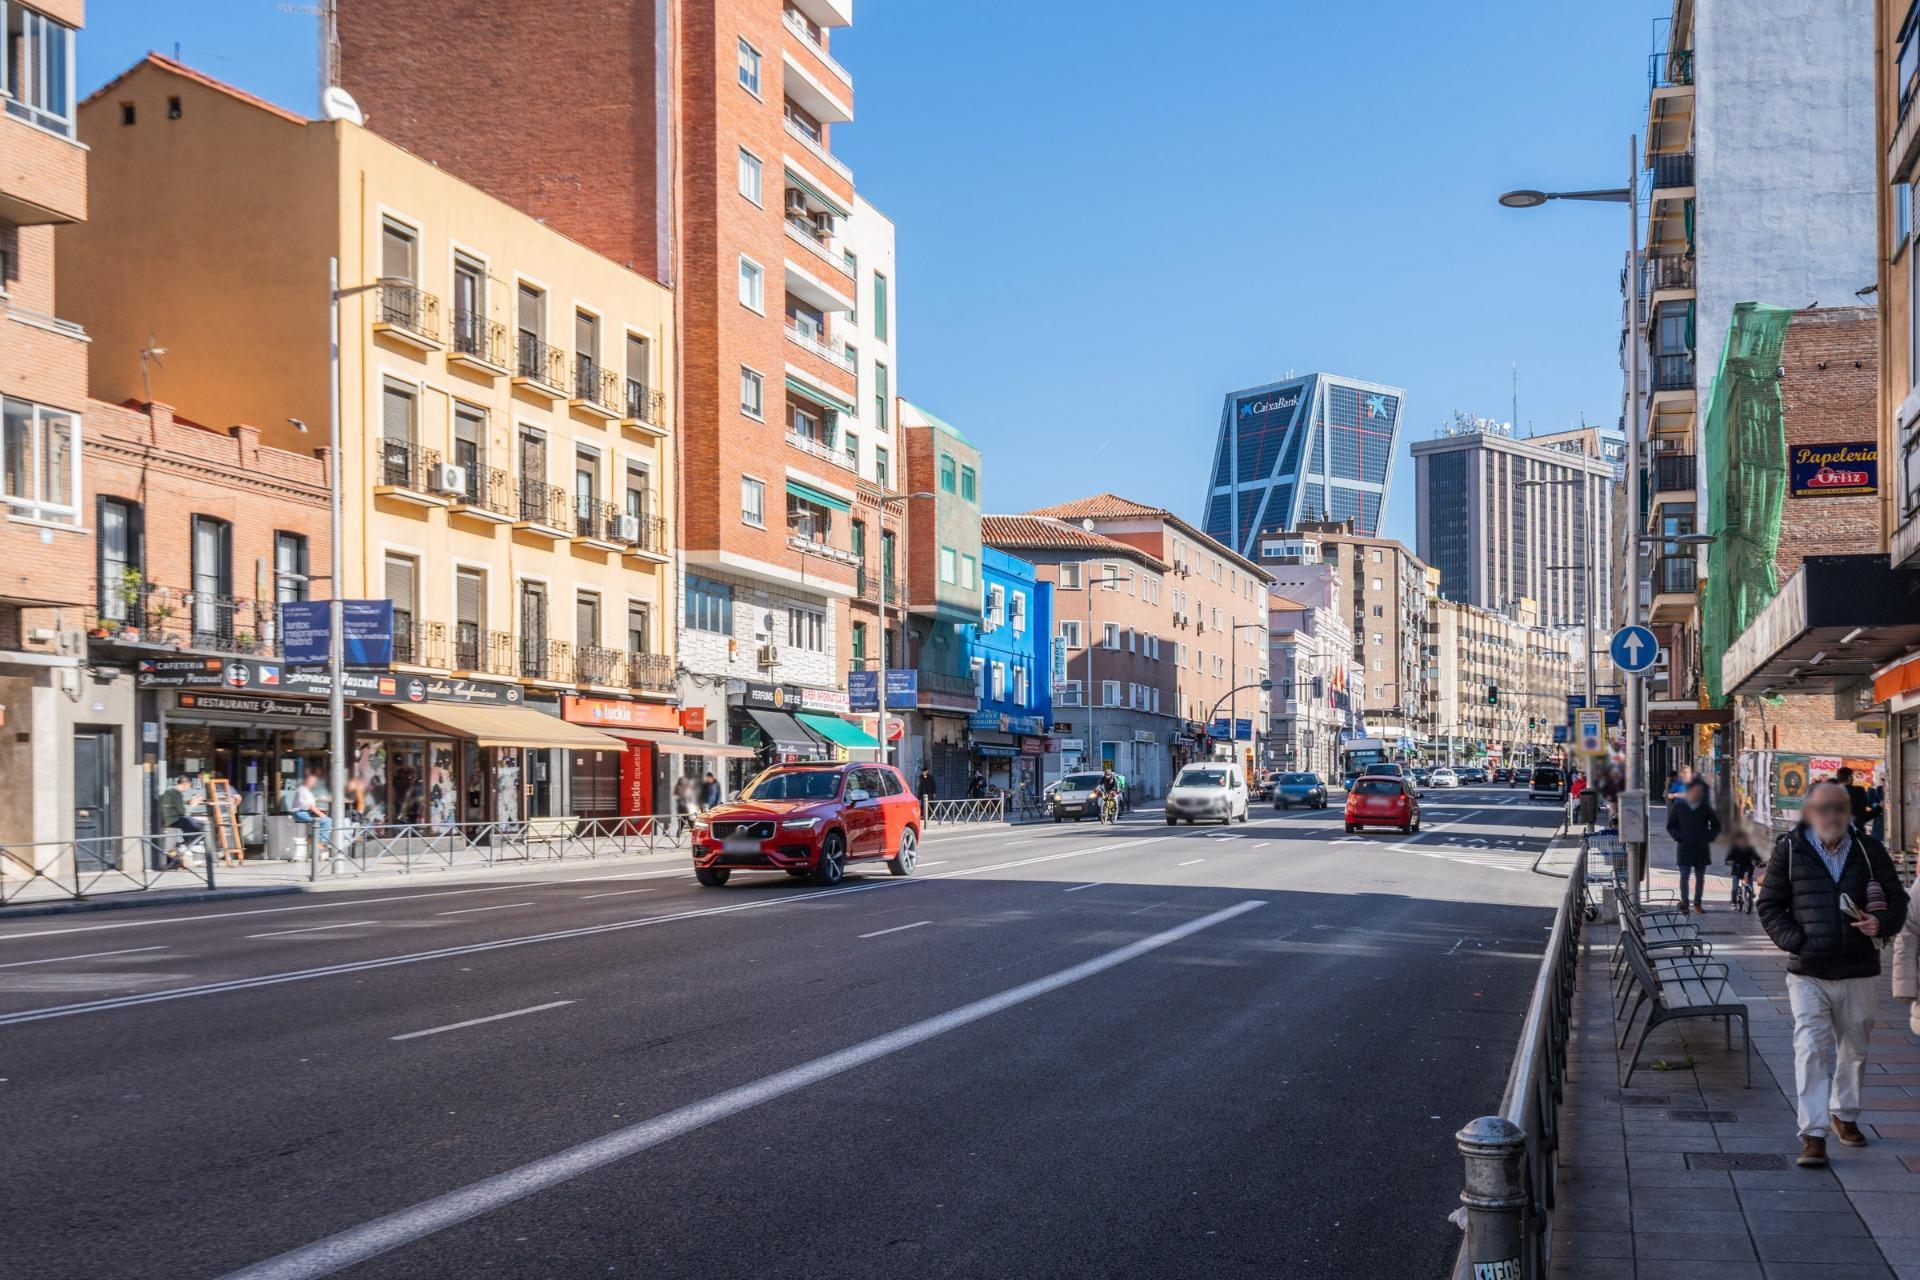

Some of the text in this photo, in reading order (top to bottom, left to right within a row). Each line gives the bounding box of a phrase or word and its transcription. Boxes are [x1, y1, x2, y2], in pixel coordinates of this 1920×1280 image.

[1253, 394, 1298, 413] CaixaBank
[1817, 471, 1861, 484] Ortiz
[158, 662, 205, 670] CAFETERIA
[186, 672, 223, 683] Pascual
[341, 672, 379, 689] Pascual
[752, 690, 773, 701] PERFUMS
[196, 697, 260, 711] RESTAURANTE
[1446, 836, 1524, 846] TAXI
